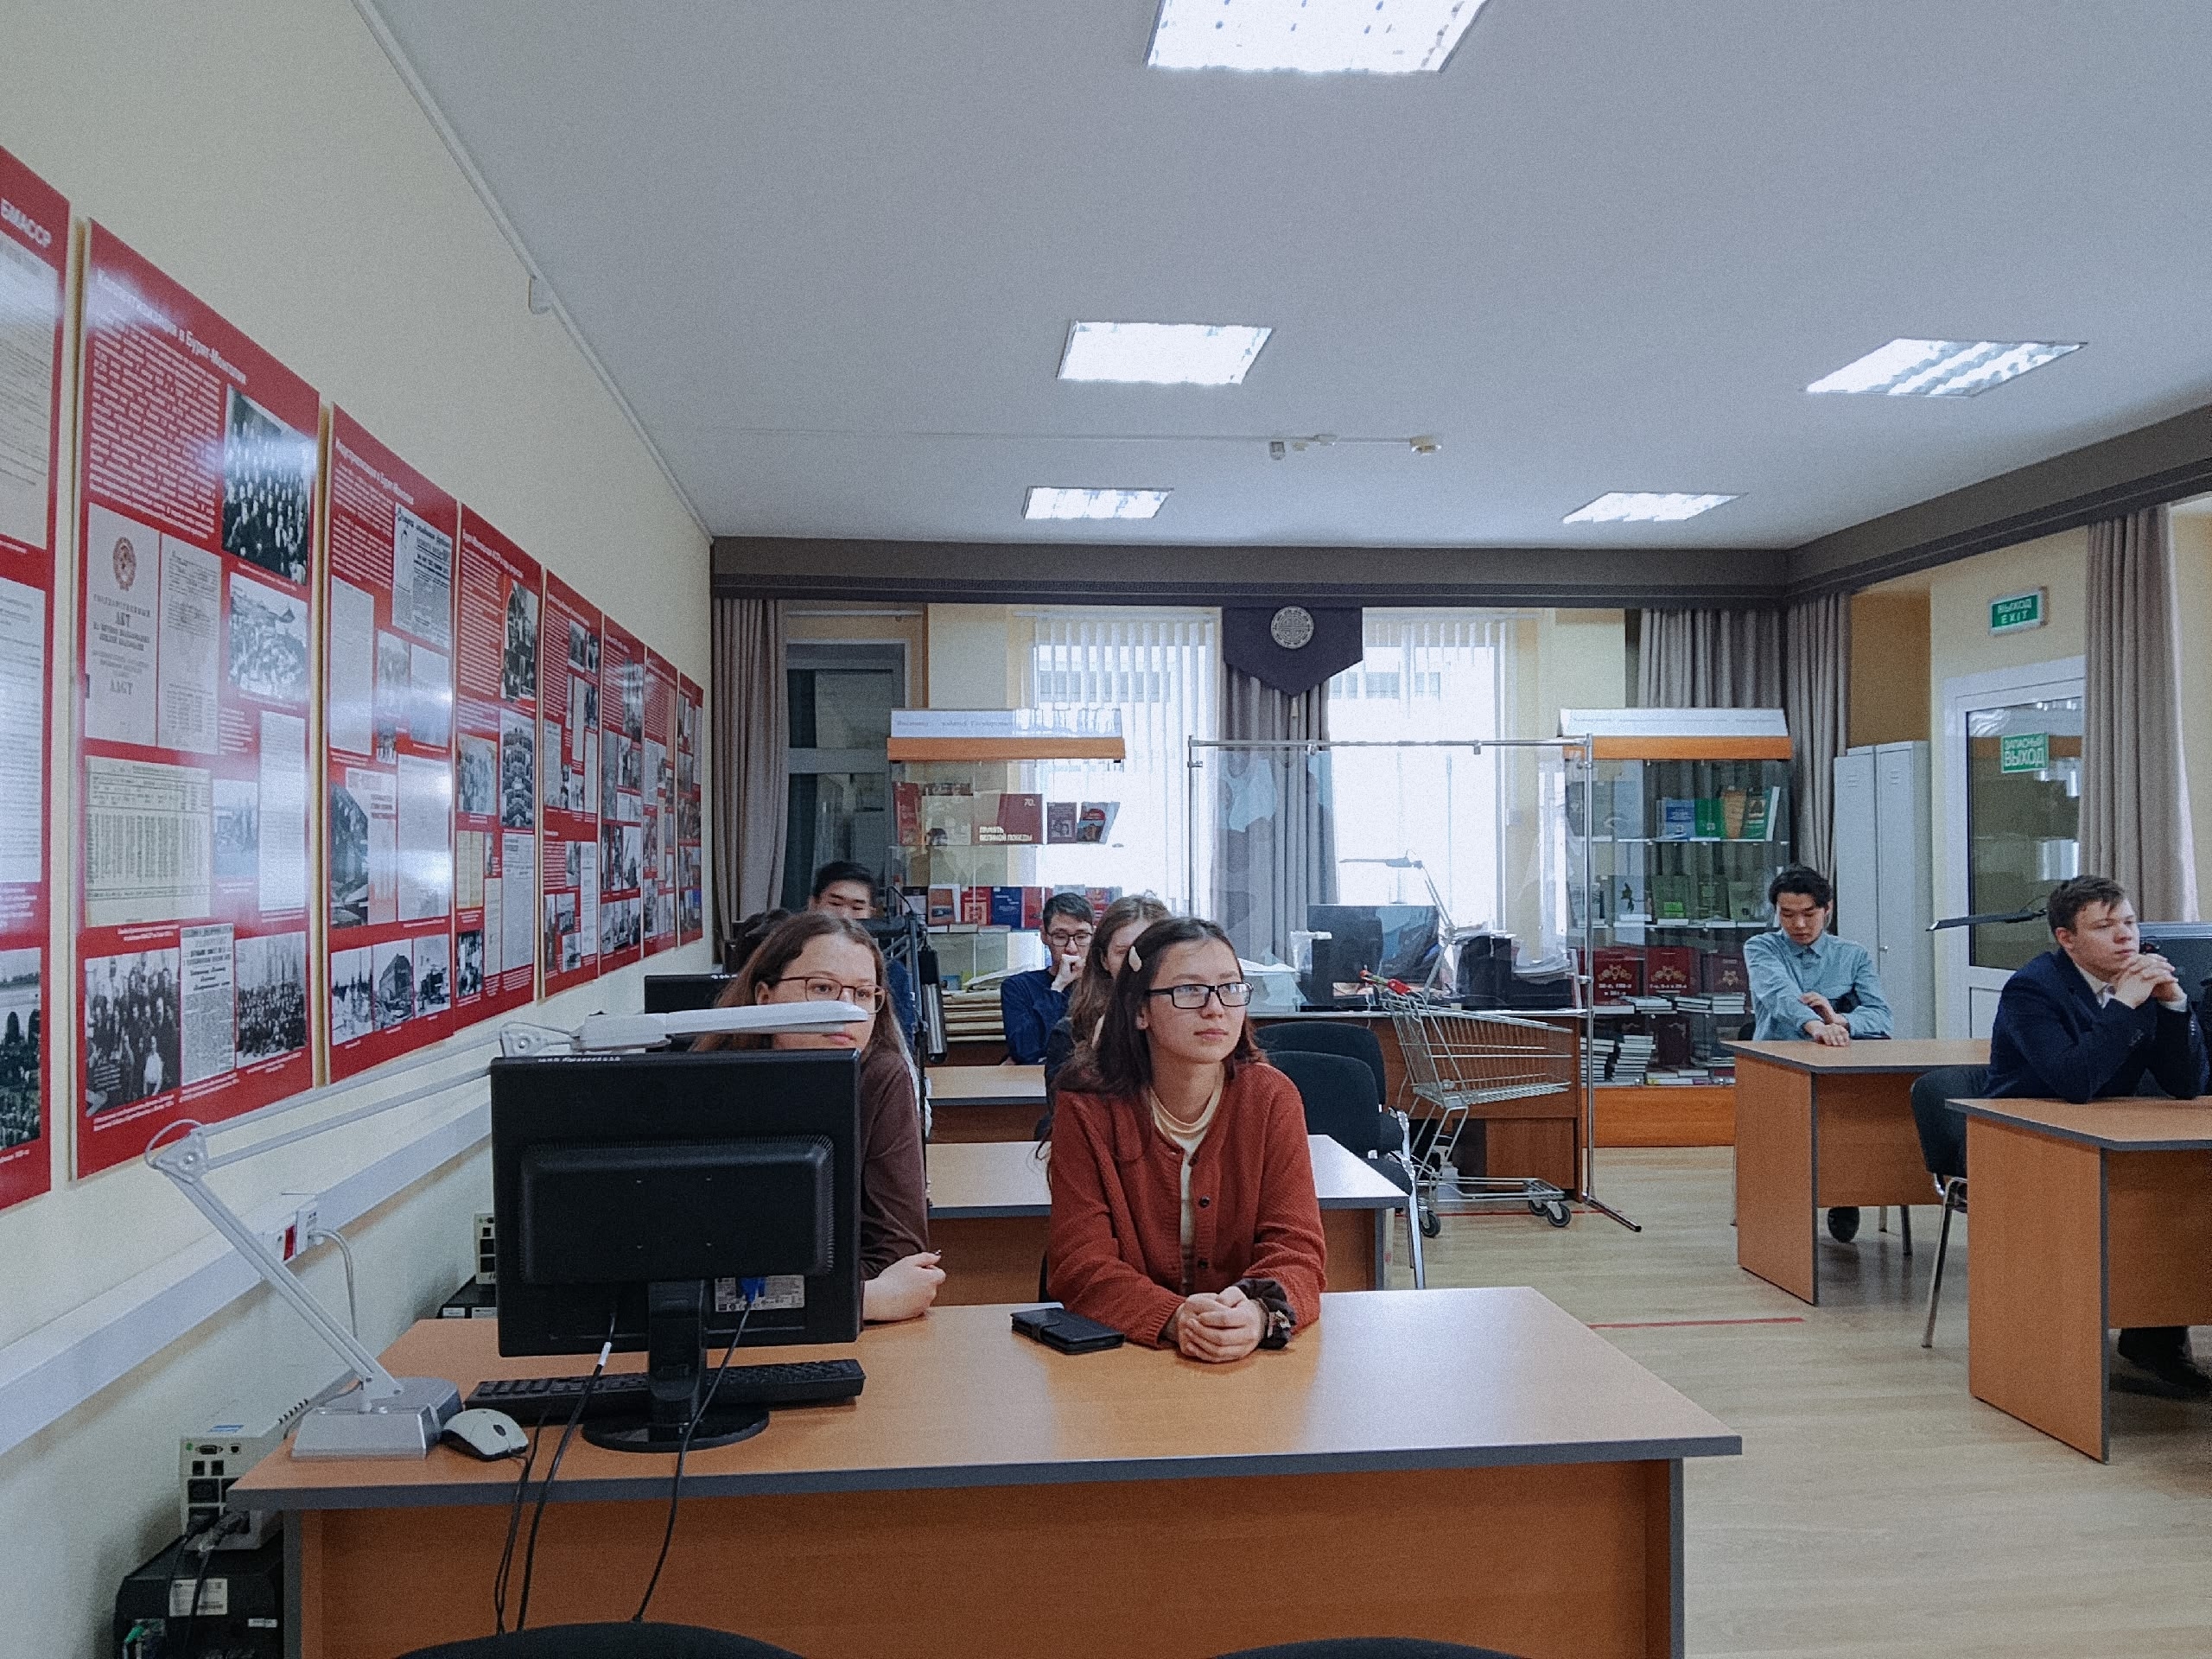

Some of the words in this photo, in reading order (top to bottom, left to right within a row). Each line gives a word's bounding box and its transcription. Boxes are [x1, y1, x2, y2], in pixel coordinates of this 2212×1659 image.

[1998, 598, 2031, 614] ВЫХОД
[2001, 610, 2028, 624] EXIT
[2005, 747, 2045, 767] ВЫХОД
